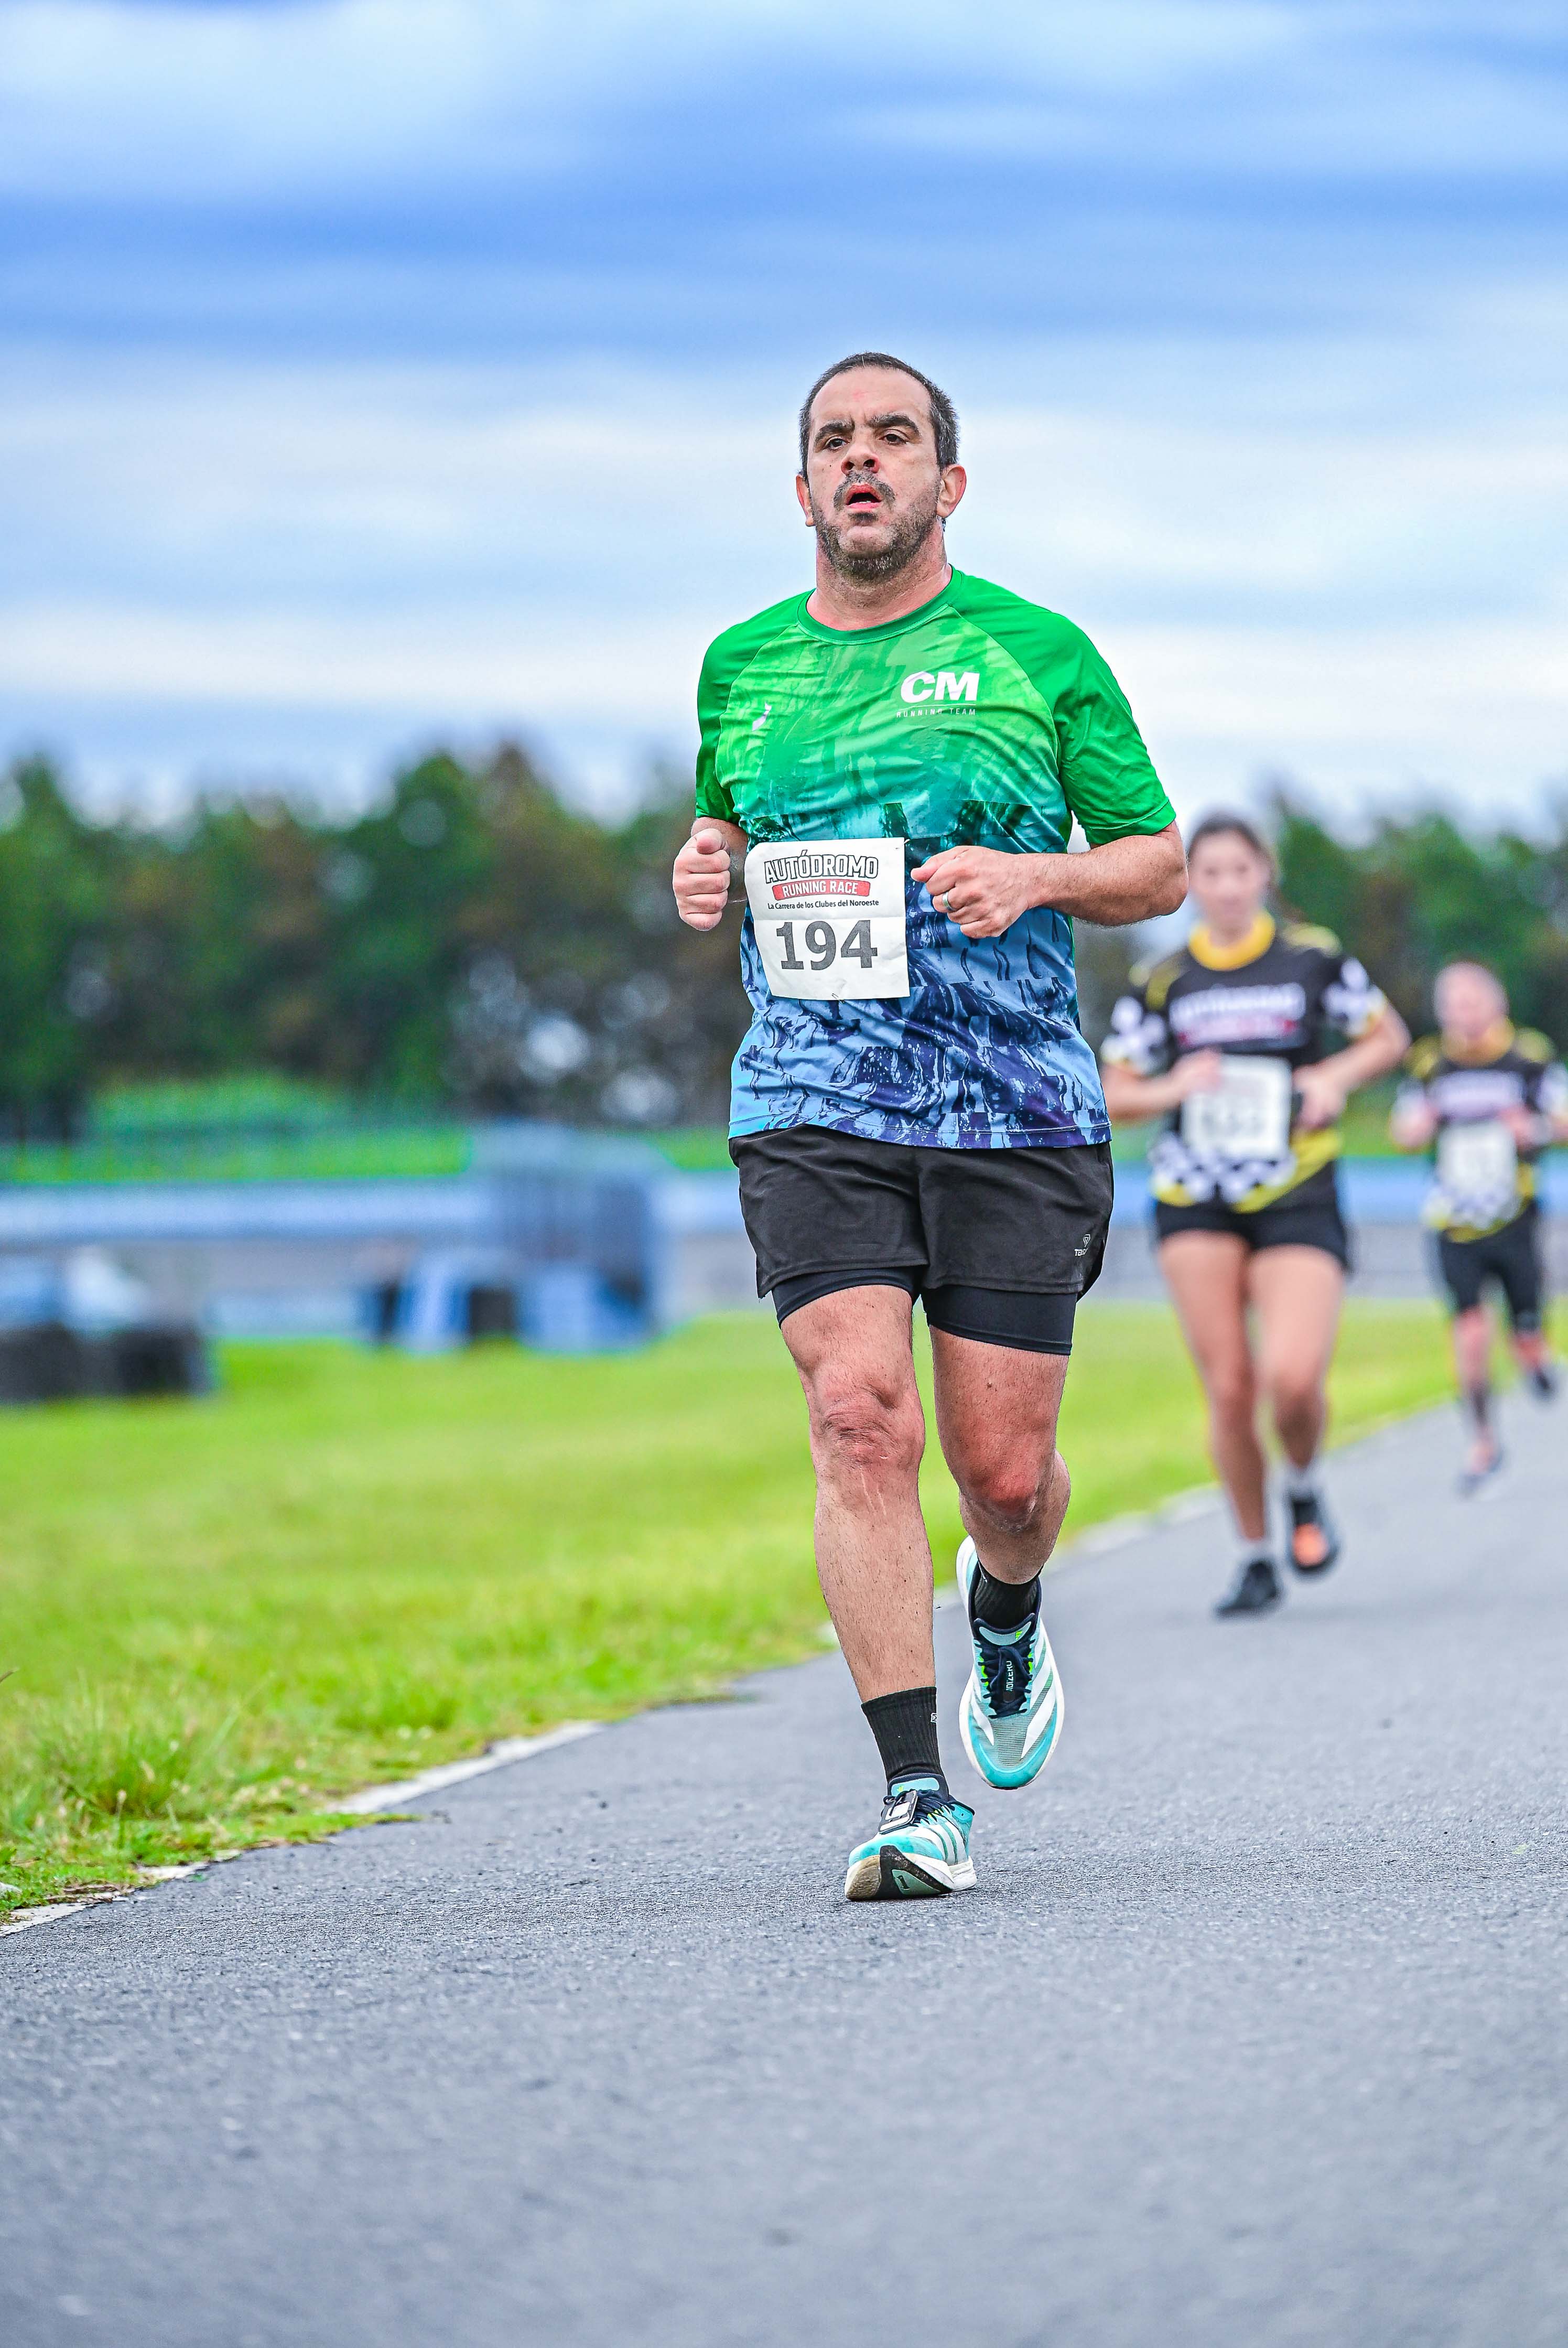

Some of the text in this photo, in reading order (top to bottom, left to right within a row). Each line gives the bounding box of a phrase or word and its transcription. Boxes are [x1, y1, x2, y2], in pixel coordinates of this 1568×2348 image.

[901, 671, 980, 703] CM
[896, 708, 943, 718] RUNNING
[764, 849, 879, 884] AUTÓDROMO
[782, 880, 859, 898] RUNNING RACE
[776, 920, 878, 970] 194
